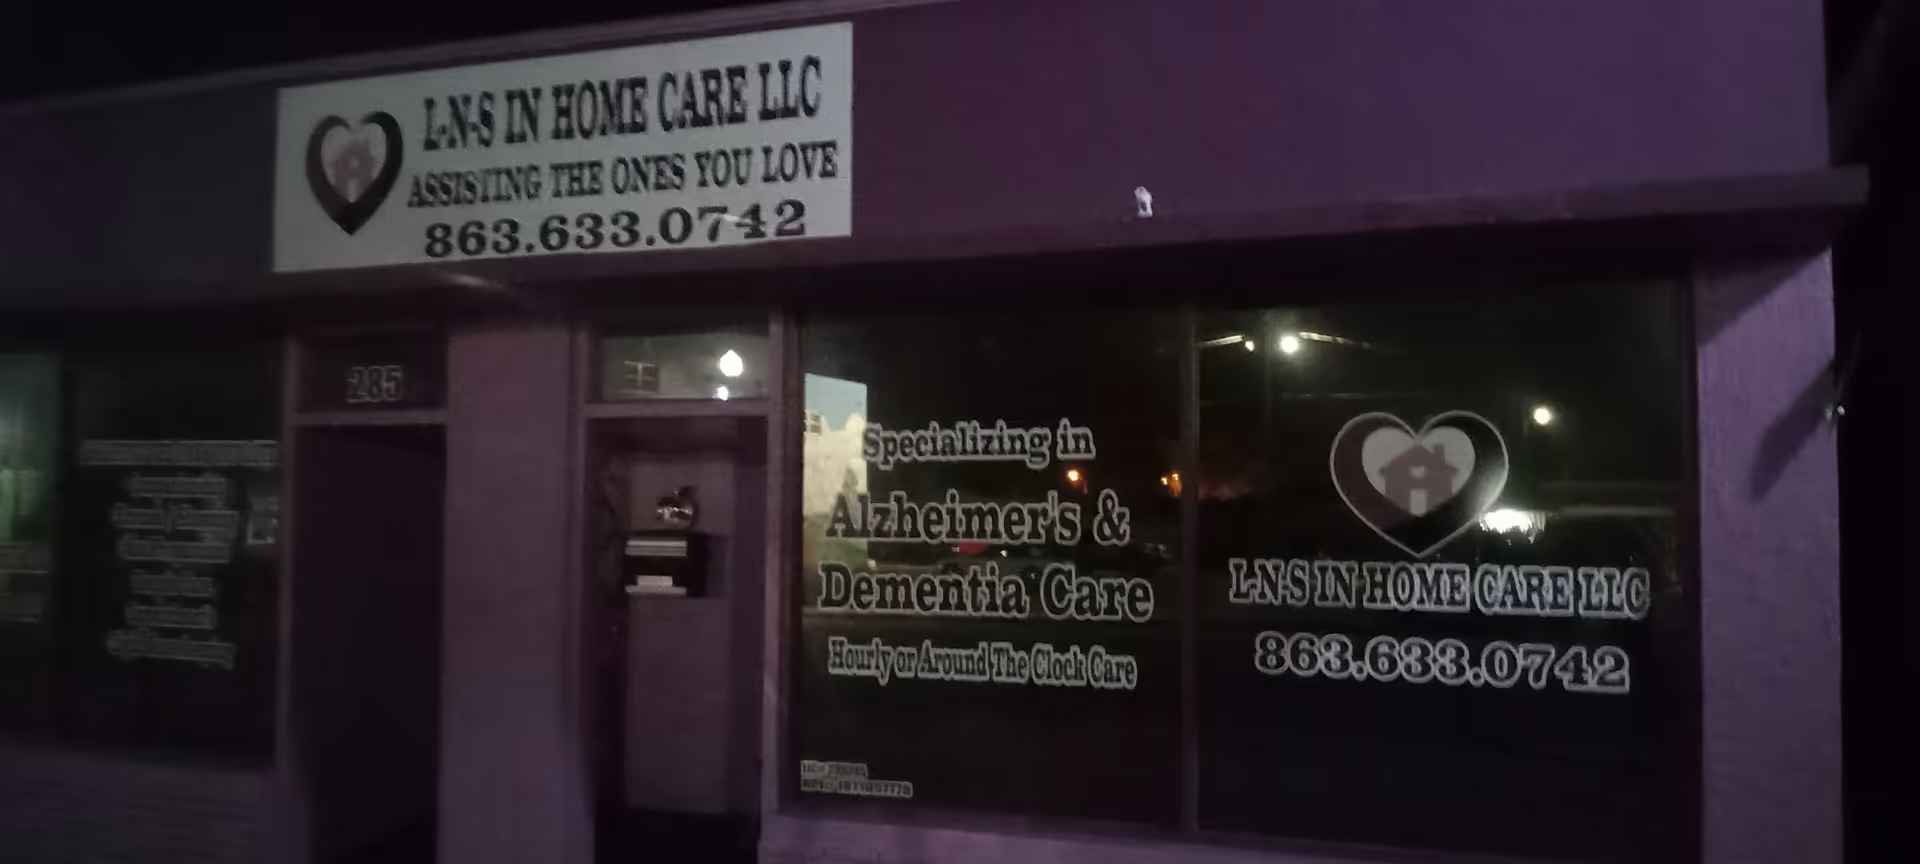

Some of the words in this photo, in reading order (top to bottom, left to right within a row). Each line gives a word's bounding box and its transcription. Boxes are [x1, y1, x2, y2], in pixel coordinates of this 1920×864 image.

[423, 92, 494, 151] L-N-S
[504, 87, 541, 144] IN
[551, 76, 648, 140] HOME
[658, 66, 746, 132] CARE
[757, 55, 821, 120] LLC
[407, 165, 542, 208] ASSISTING
[551, 160, 602, 198] THE
[611, 154, 684, 194] ONES
[694, 147, 753, 187] YOU
[762, 140, 838, 182] LOVE
[424, 200, 807, 258] 863.633.0742
[345, 364, 404, 403] 285
[862, 419, 1051, 472] Specializing
[1056, 417, 1096, 460] in
[825, 488, 1082, 546] Alzheimer's
[1092, 488, 1130, 546] &
[818, 560, 1030, 619] Dementia
[1040, 562, 1155, 623] Care
[1313, 561, 1358, 609] IN
[1362, 561, 1471, 614] HOME
[1473, 563, 1574, 618] CARE
[1577, 566, 1651, 621] LLC
[828, 635, 893, 687] Hourly
[893, 645, 917, 679] or
[917, 639, 990, 683] Around
[990, 641, 1030, 684] The
[1031, 642, 1087, 687] Clock
[1088, 645, 1138, 690] Care
[1254, 630, 1631, 695] 863.633.0742
